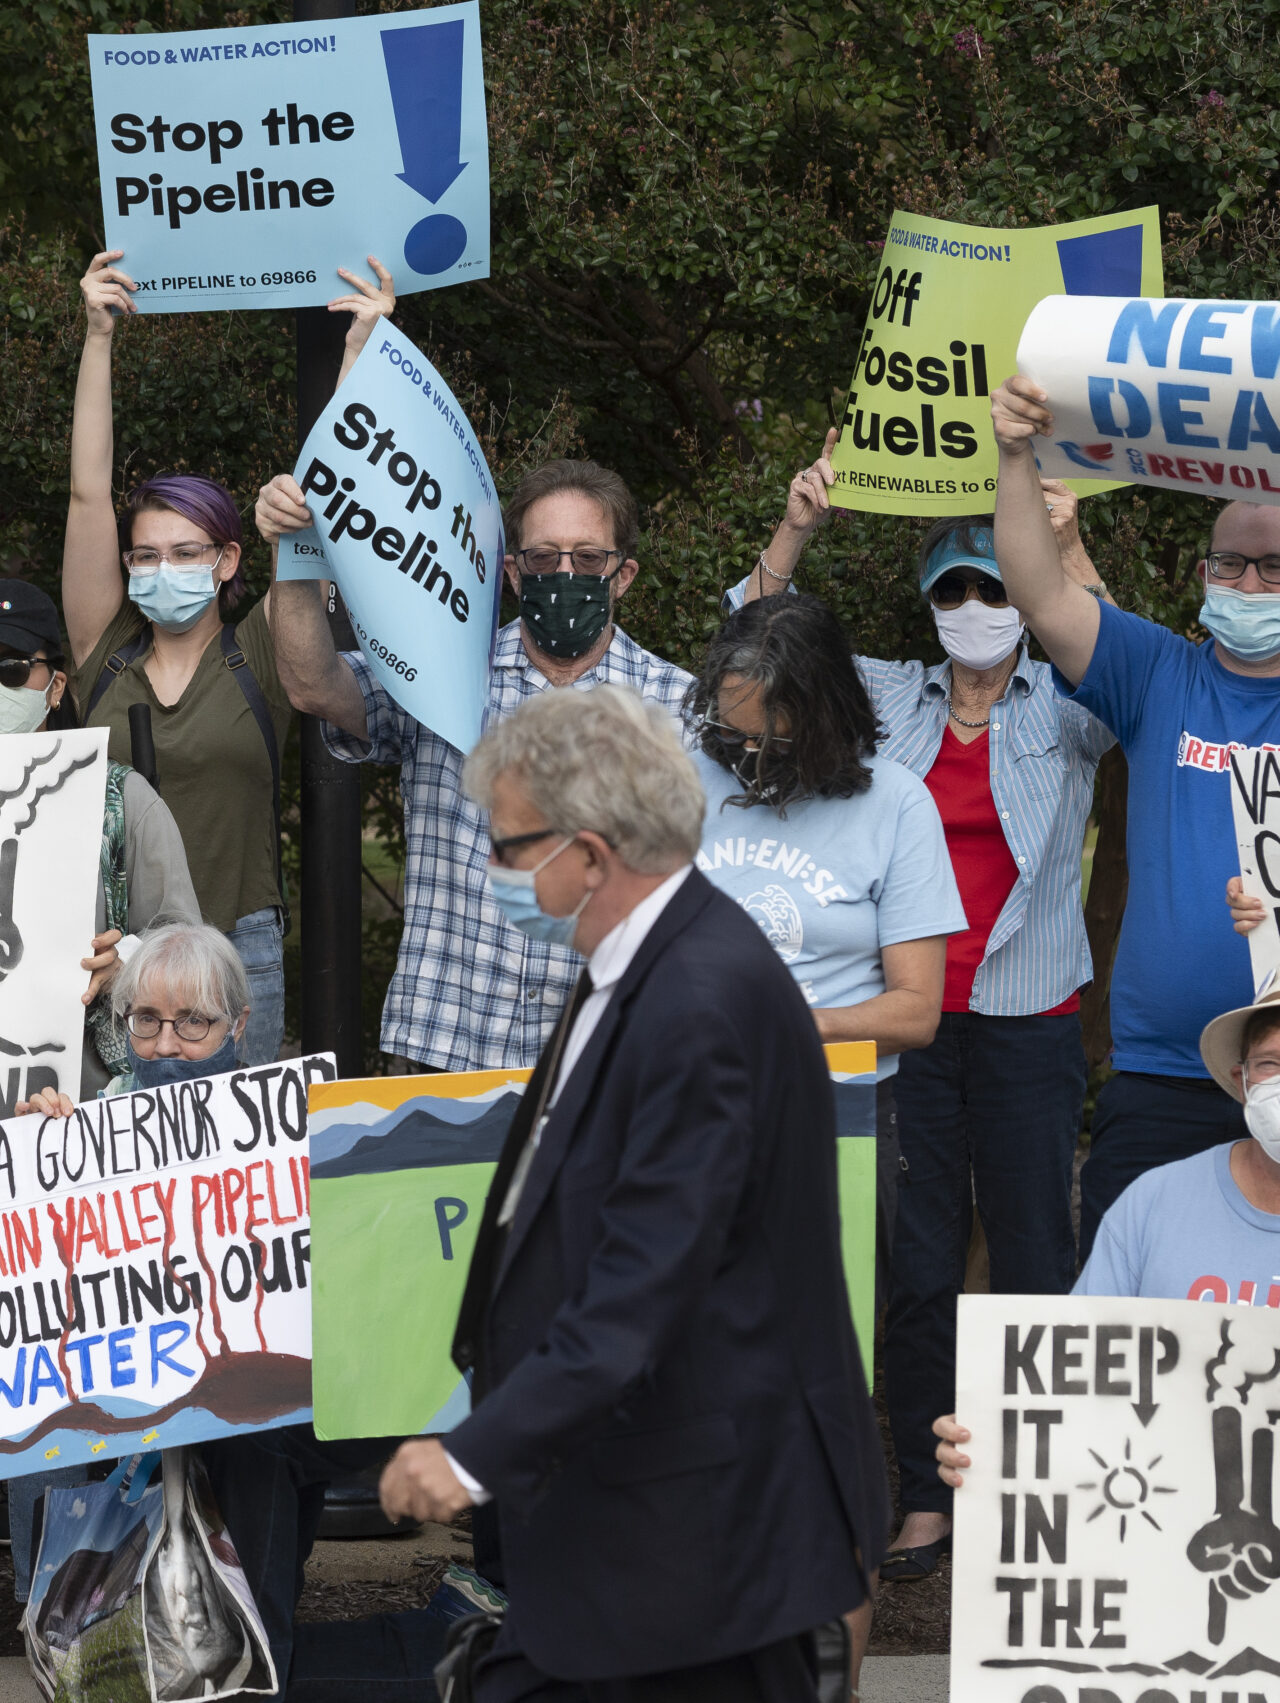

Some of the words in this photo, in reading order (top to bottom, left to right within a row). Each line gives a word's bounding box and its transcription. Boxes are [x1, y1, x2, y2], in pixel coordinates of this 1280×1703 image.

[104, 49, 161, 66] FOOD
[164, 48, 178, 64] &
[180, 43, 247, 63] WATER
[251, 35, 337, 58] ACTION!
[110, 113, 244, 164] Stop
[261, 103, 355, 146] the
[115, 167, 335, 230] Pipeline
[890, 227, 905, 245] FOOD
[909, 231, 938, 253] WATER
[940, 239, 1011, 262] ACTION!
[134, 280, 157, 292] ext
[162, 275, 235, 290] PIPELINE
[240, 276, 256, 287] to
[261, 270, 317, 285] 69866
[873, 265, 922, 327] Off
[853, 328, 989, 397] Fossil
[379, 340, 423, 386] FOOD
[422, 381, 432, 399] &
[432, 390, 465, 446] WATER
[464, 440, 492, 506] ACTION!
[837, 391, 978, 459] Fuels
[333, 403, 442, 514] Stop
[451, 502, 487, 584] the
[849, 470, 957, 494] RENEWABLES
[961, 480, 980, 493] to
[1126, 448, 1149, 477] OUR
[300, 457, 469, 623] Pipeline
[356, 623, 368, 641] to
[369, 638, 418, 682] 69866
[36, 1080, 220, 1192] GOVERNOR
[47, 1178, 177, 1264] VALLEY
[1003, 1324, 1180, 1426] KEEP
[1001, 1408, 1063, 1480] IT
[1000, 1493, 1068, 1564] IN
[995, 1576, 1128, 1649] THE
